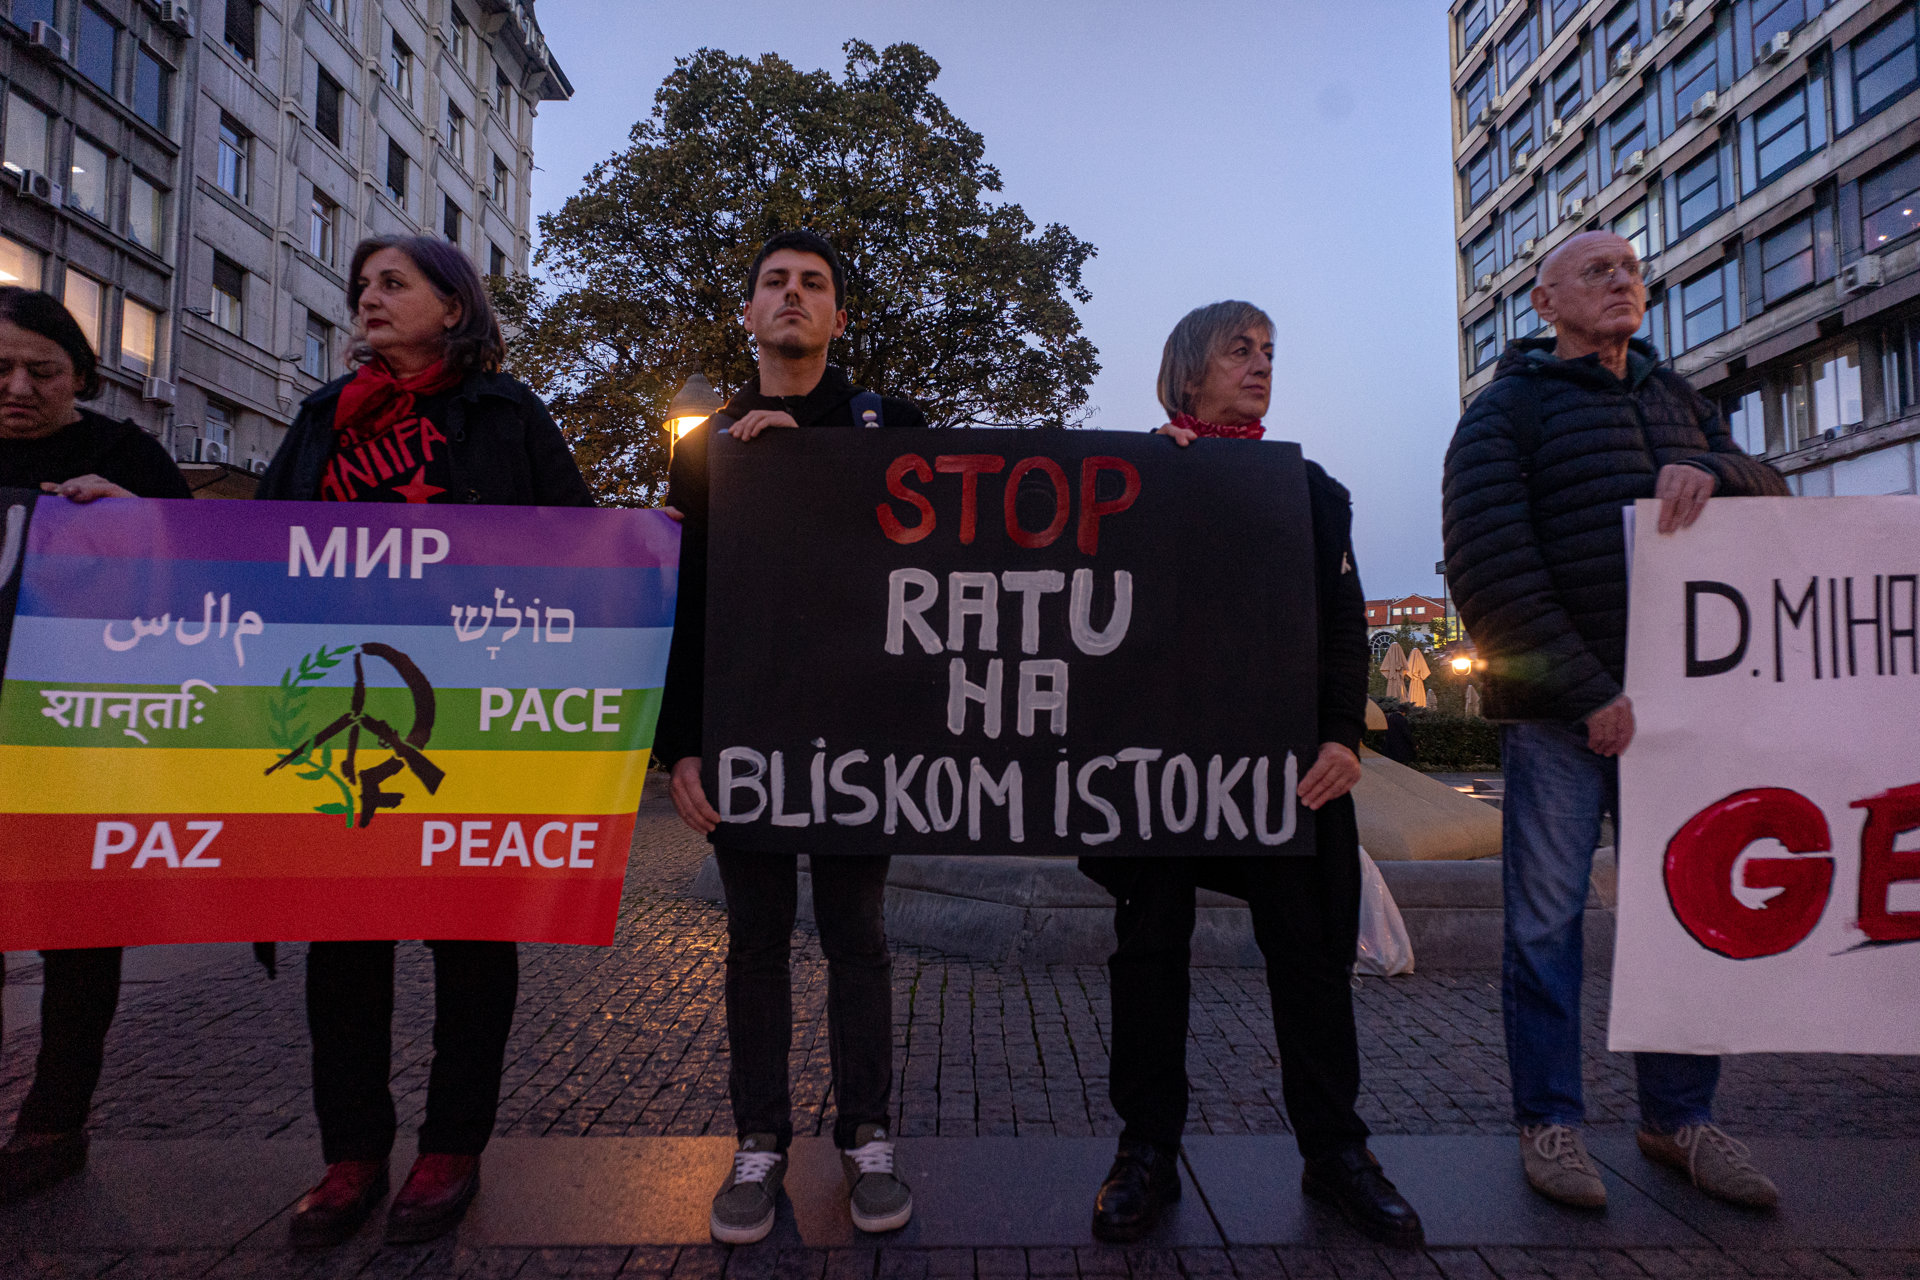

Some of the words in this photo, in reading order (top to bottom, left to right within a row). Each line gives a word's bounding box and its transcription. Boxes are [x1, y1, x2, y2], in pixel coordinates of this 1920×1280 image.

[876, 453, 1142, 555] STOP
[288, 525, 450, 579] МИР
[884, 567, 1133, 656] RATU
[479, 686, 623, 733] PACE
[947, 657, 1069, 738] NA
[90, 820, 224, 870] PAZ
[420, 820, 599, 869] PEACE
